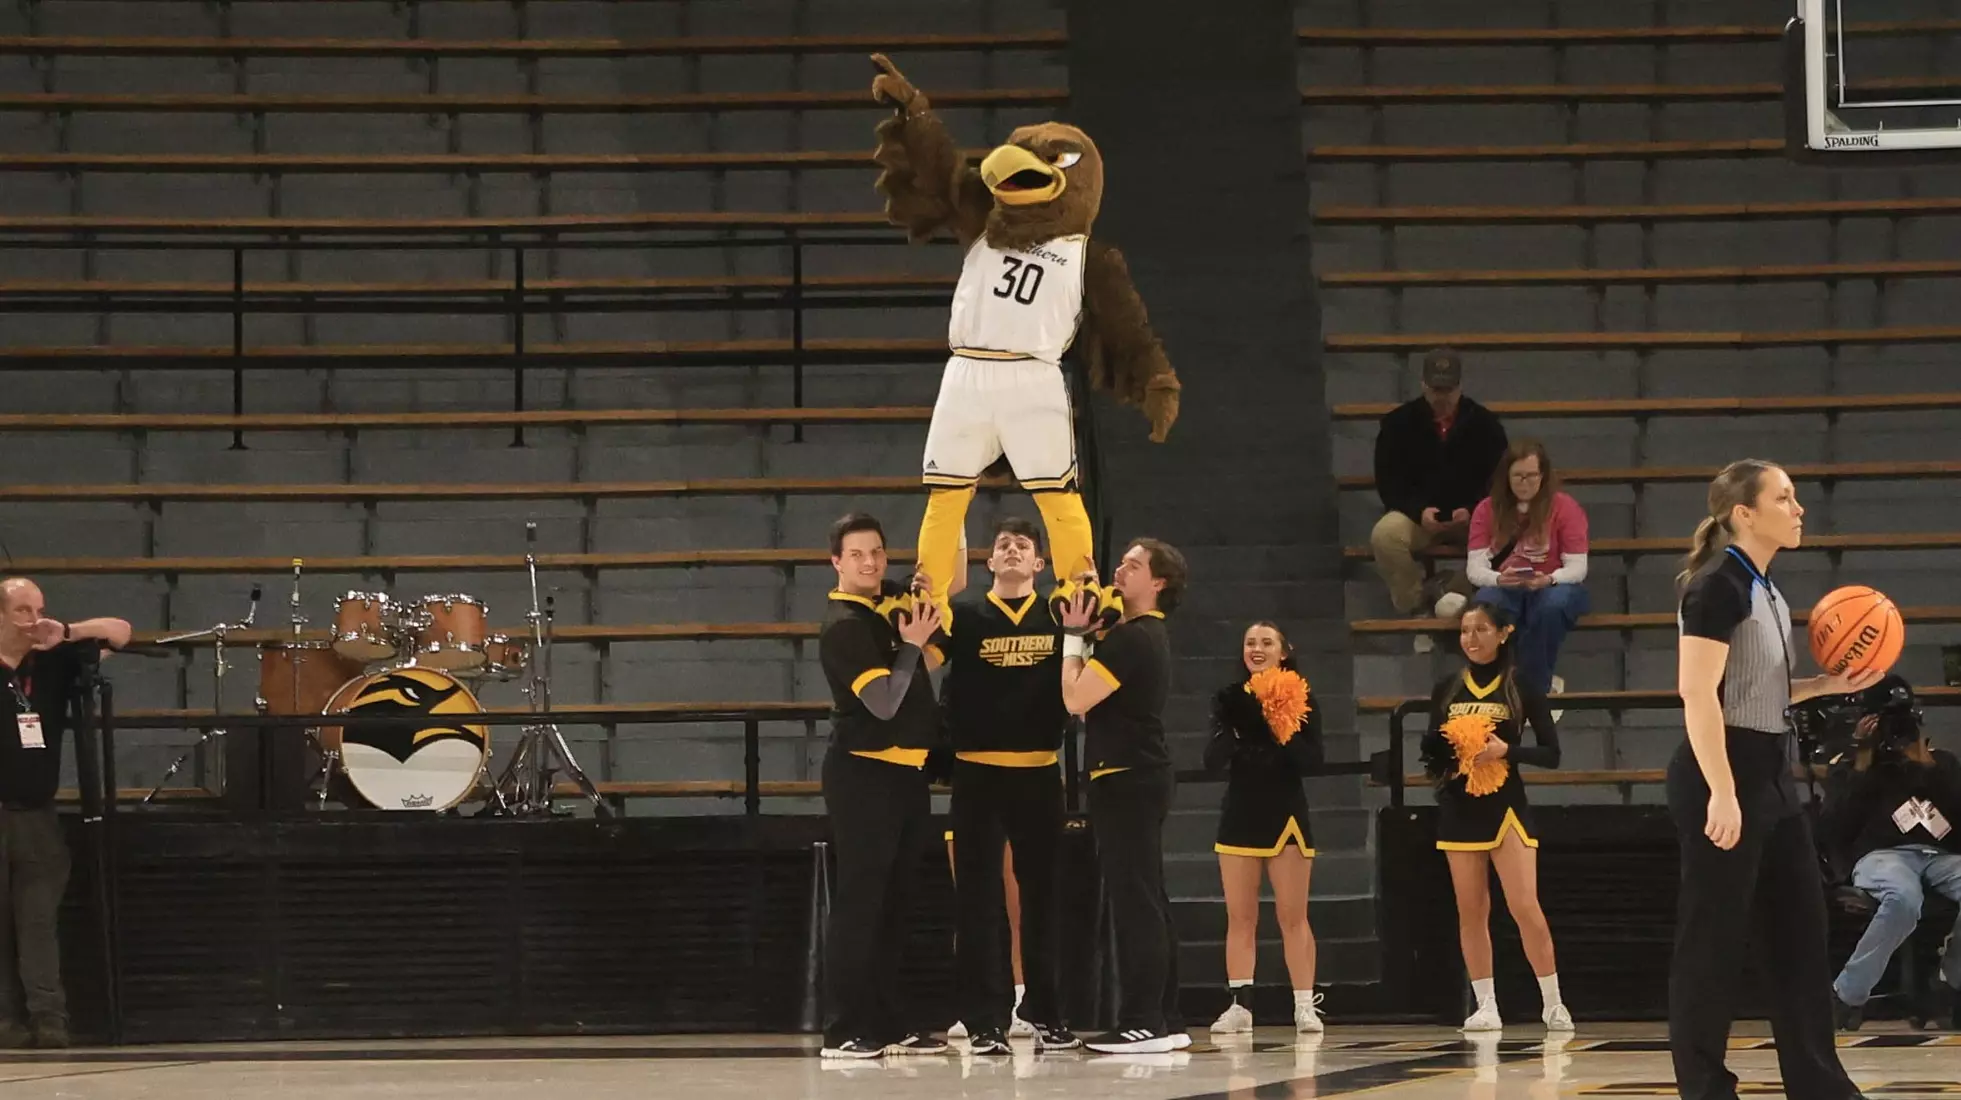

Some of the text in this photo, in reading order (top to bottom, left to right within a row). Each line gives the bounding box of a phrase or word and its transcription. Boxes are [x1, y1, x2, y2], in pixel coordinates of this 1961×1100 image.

[1824, 134, 1879, 149] SPALDING
[993, 255, 1044, 305] 30
[980, 634, 1055, 654] SOUTHERN
[1833, 624, 1880, 673] Wilson
[1001, 651, 1035, 667] MISS
